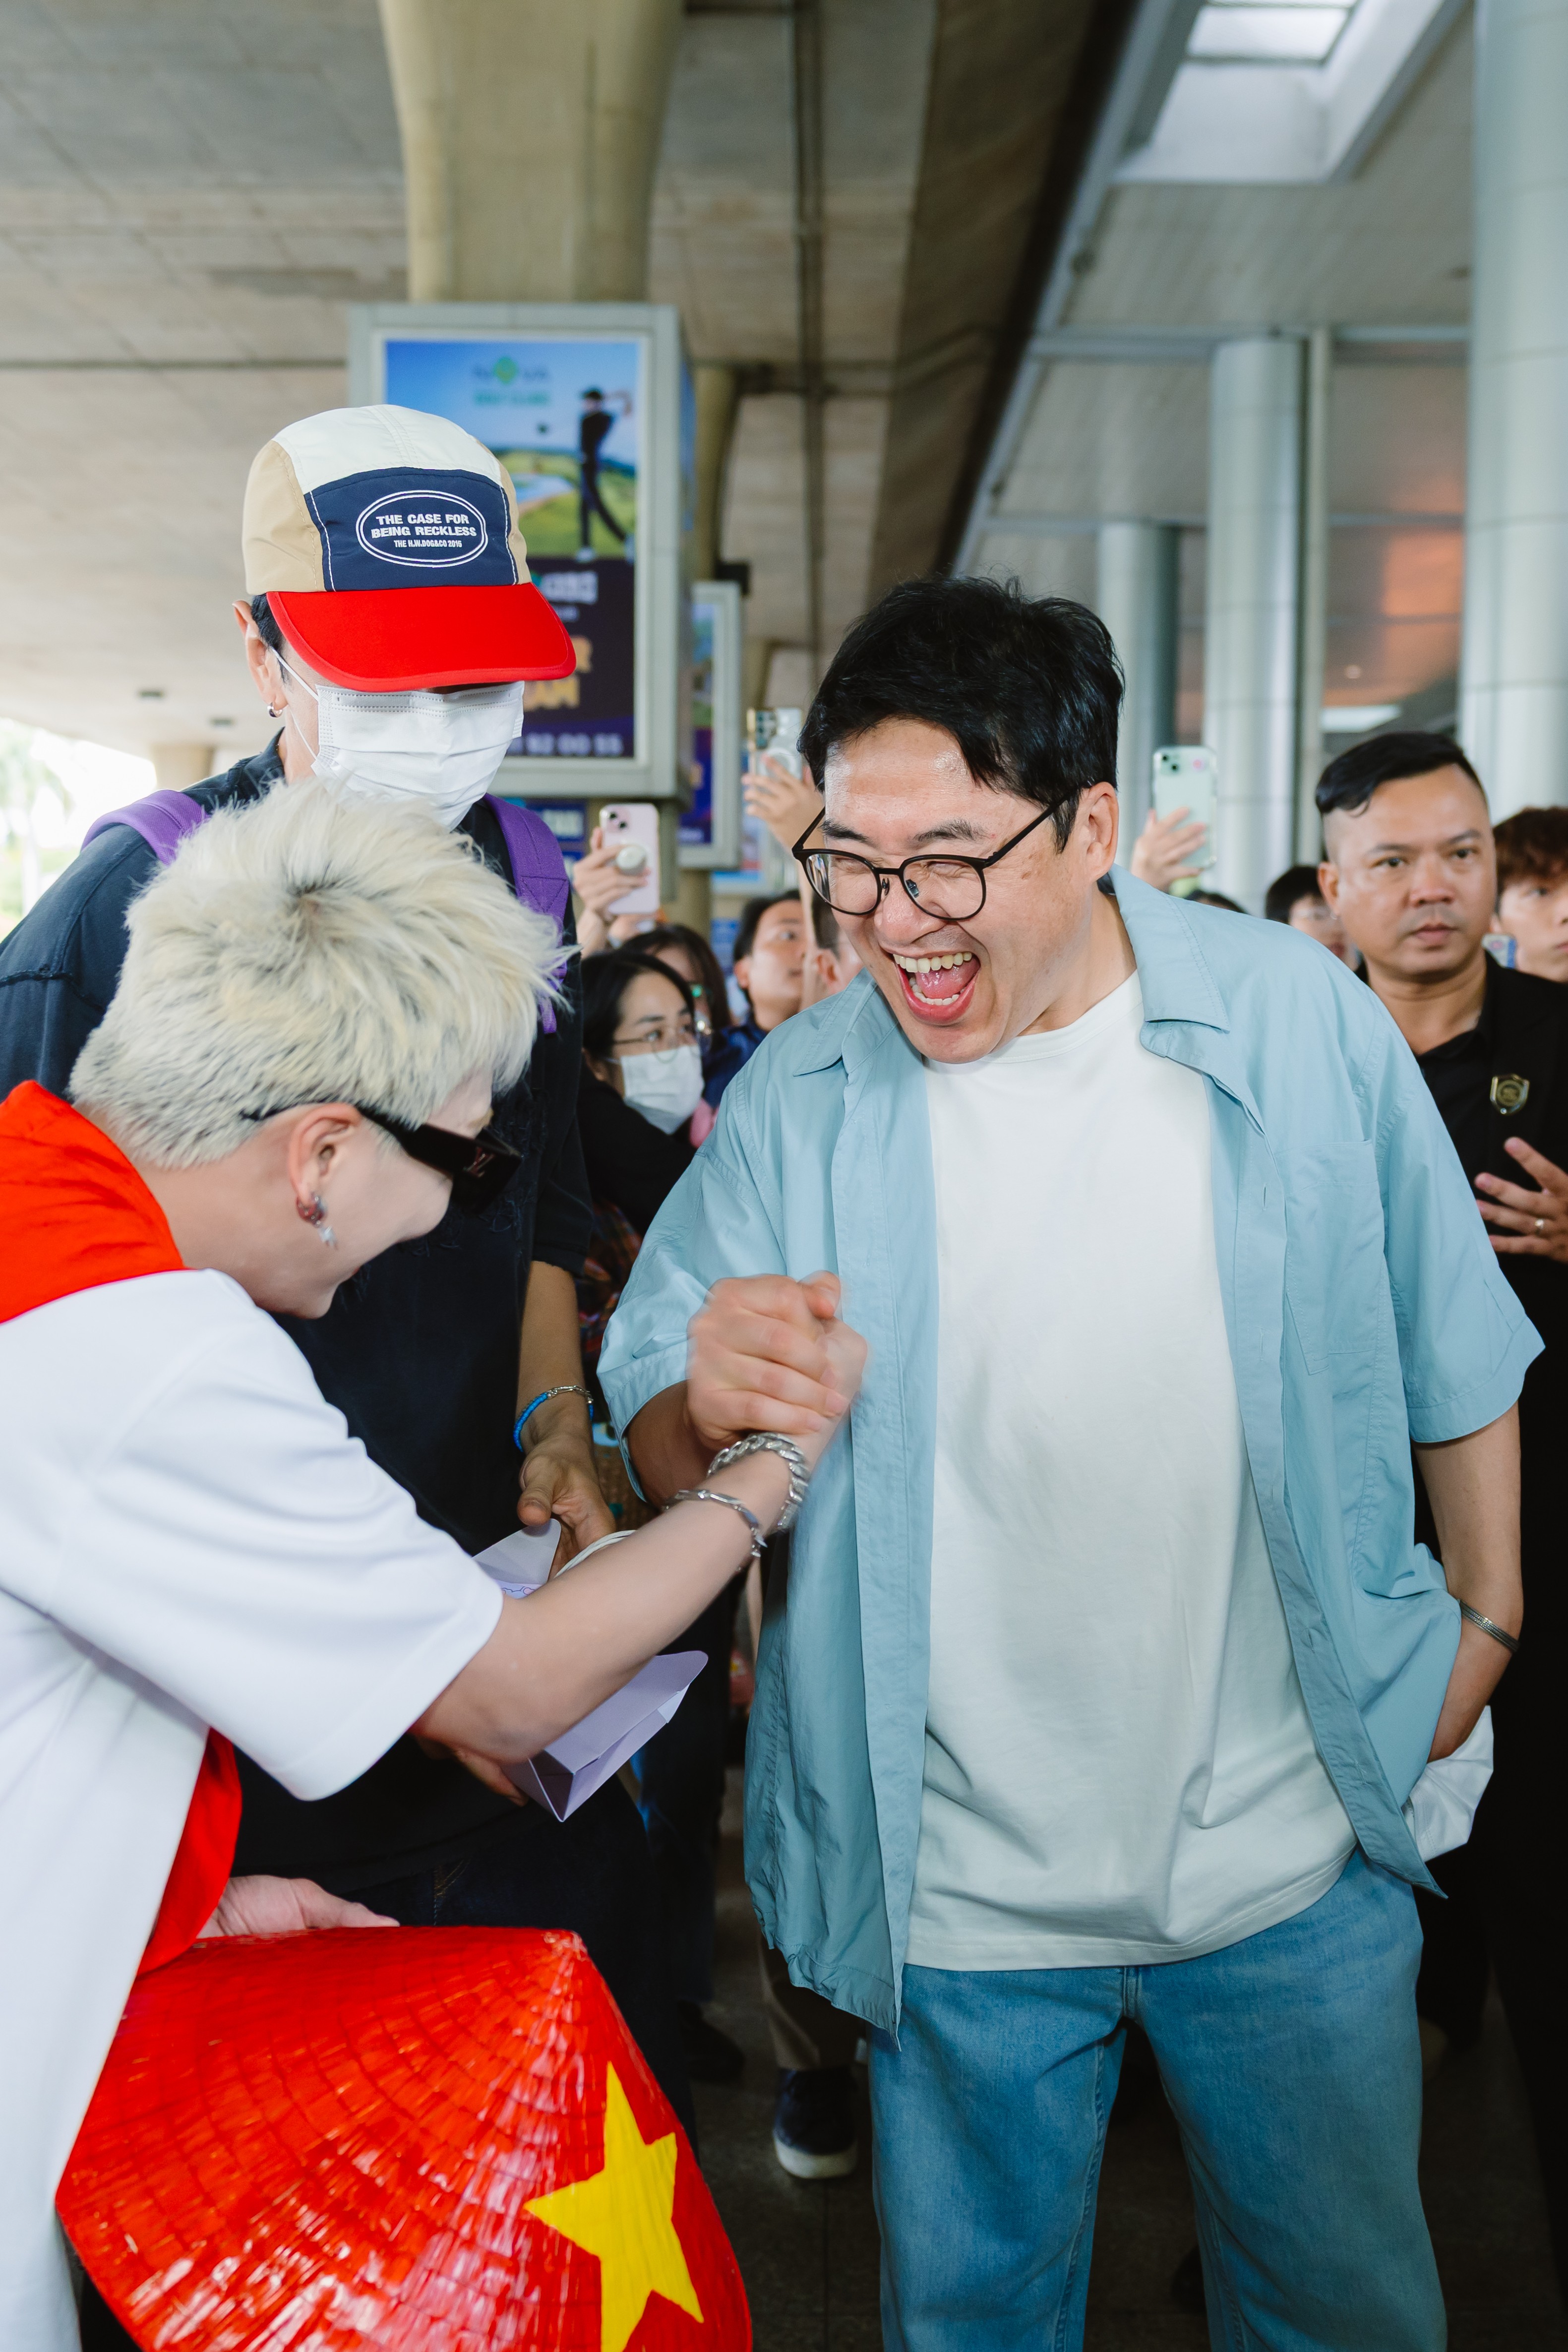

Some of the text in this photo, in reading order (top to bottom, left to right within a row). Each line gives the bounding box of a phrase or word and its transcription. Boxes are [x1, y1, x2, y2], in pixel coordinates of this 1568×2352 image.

[375, 514, 470, 525] THE CASE FOR
[371, 526, 477, 539] BEING RECKLESS
